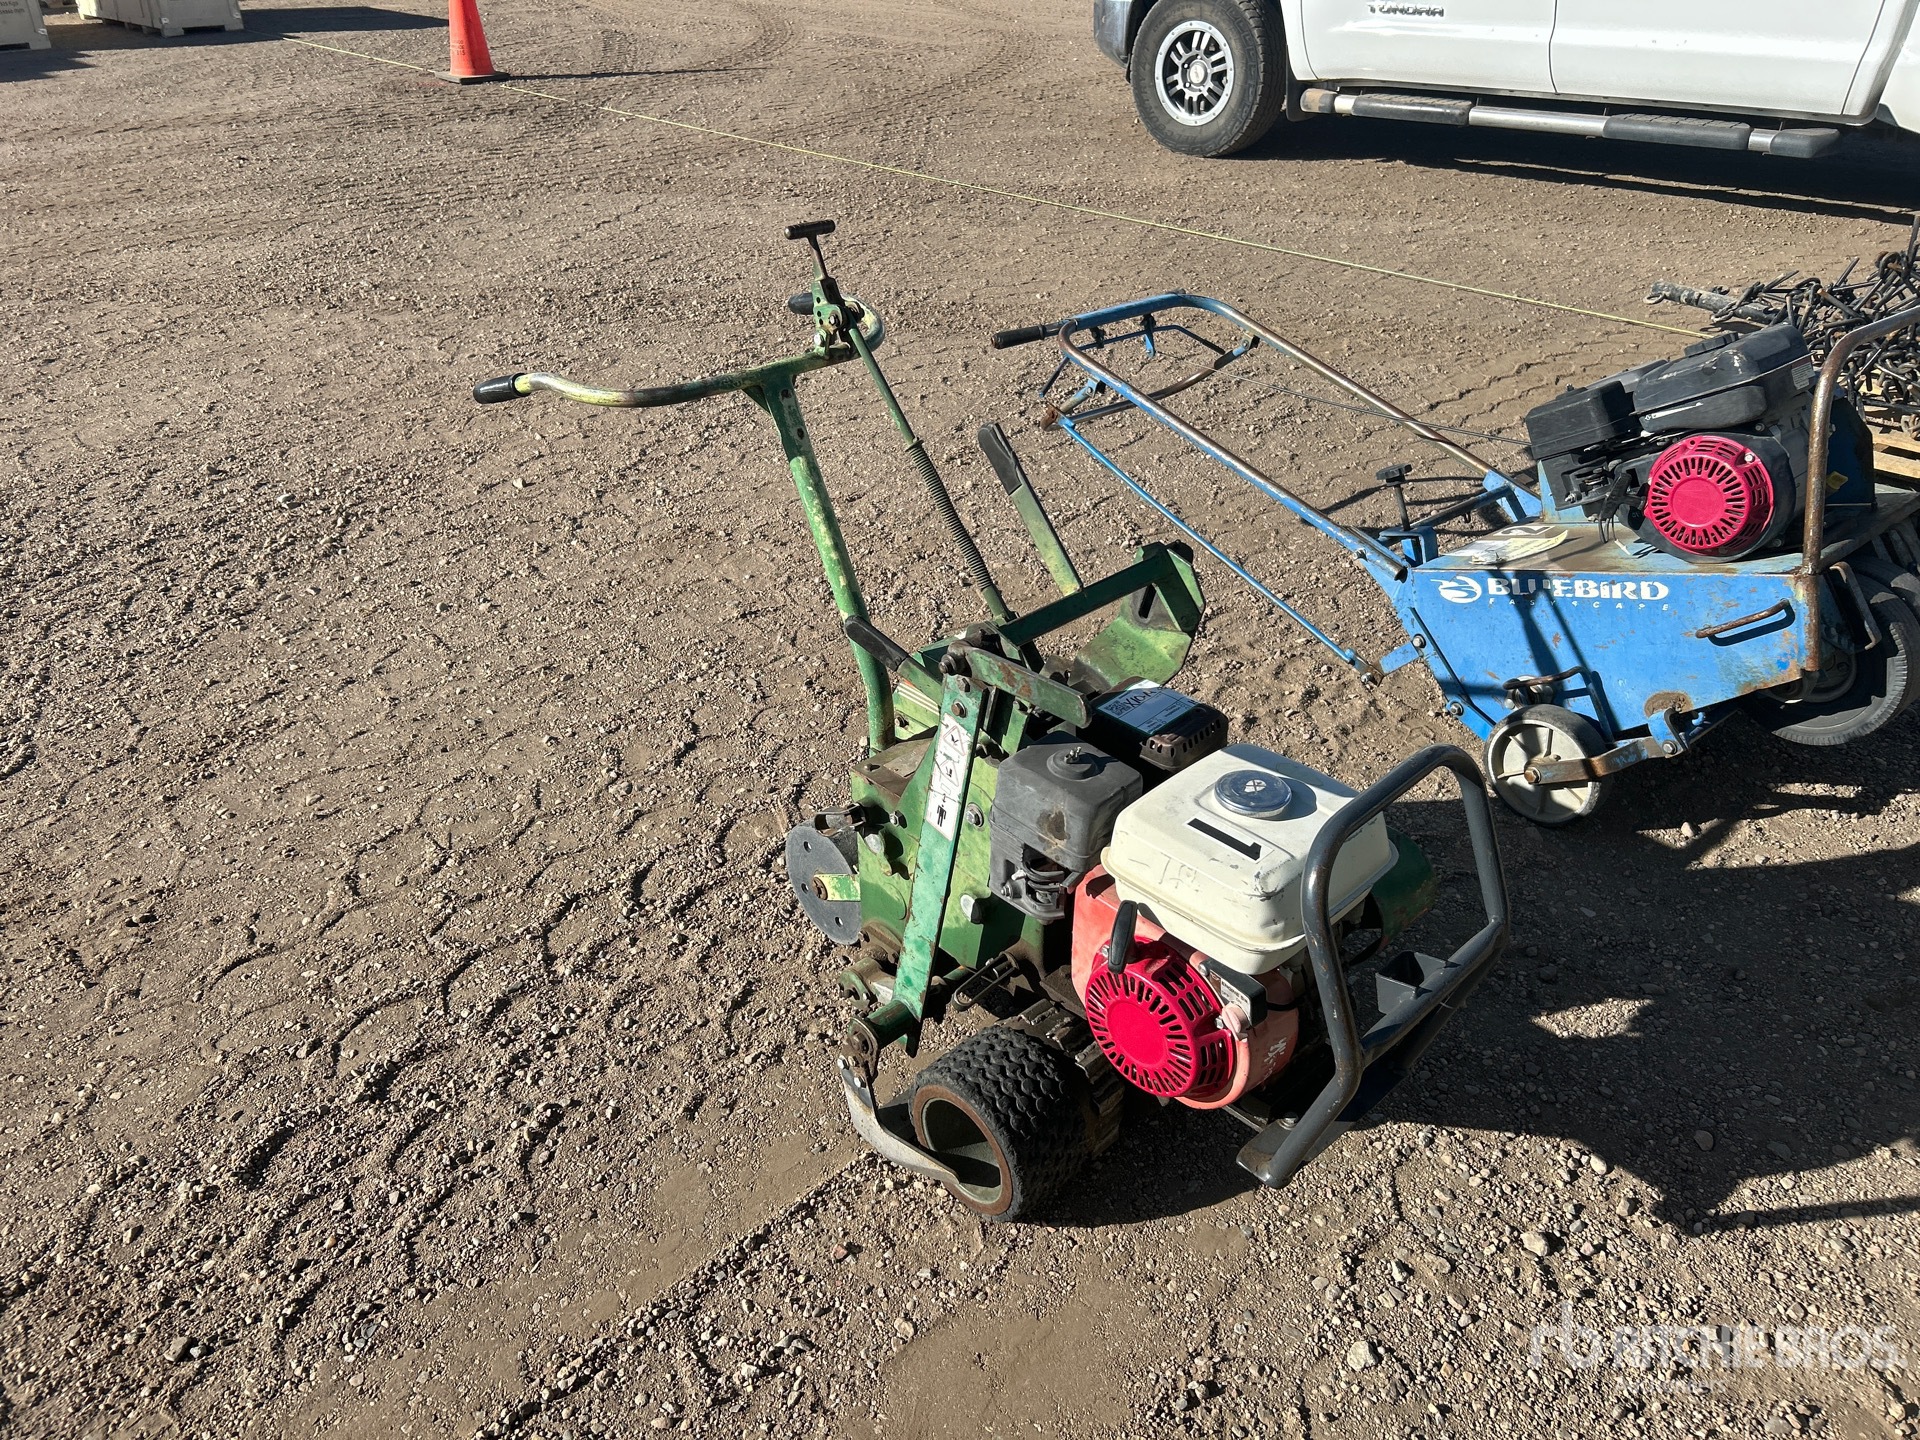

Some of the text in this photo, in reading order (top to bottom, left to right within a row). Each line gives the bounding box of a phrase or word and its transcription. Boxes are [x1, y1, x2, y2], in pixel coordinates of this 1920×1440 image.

[1367, 4, 1444, 17] TUNDRA
[1487, 577, 1669, 600] BLUEBIRD
[1187, 818, 1262, 861] 1
